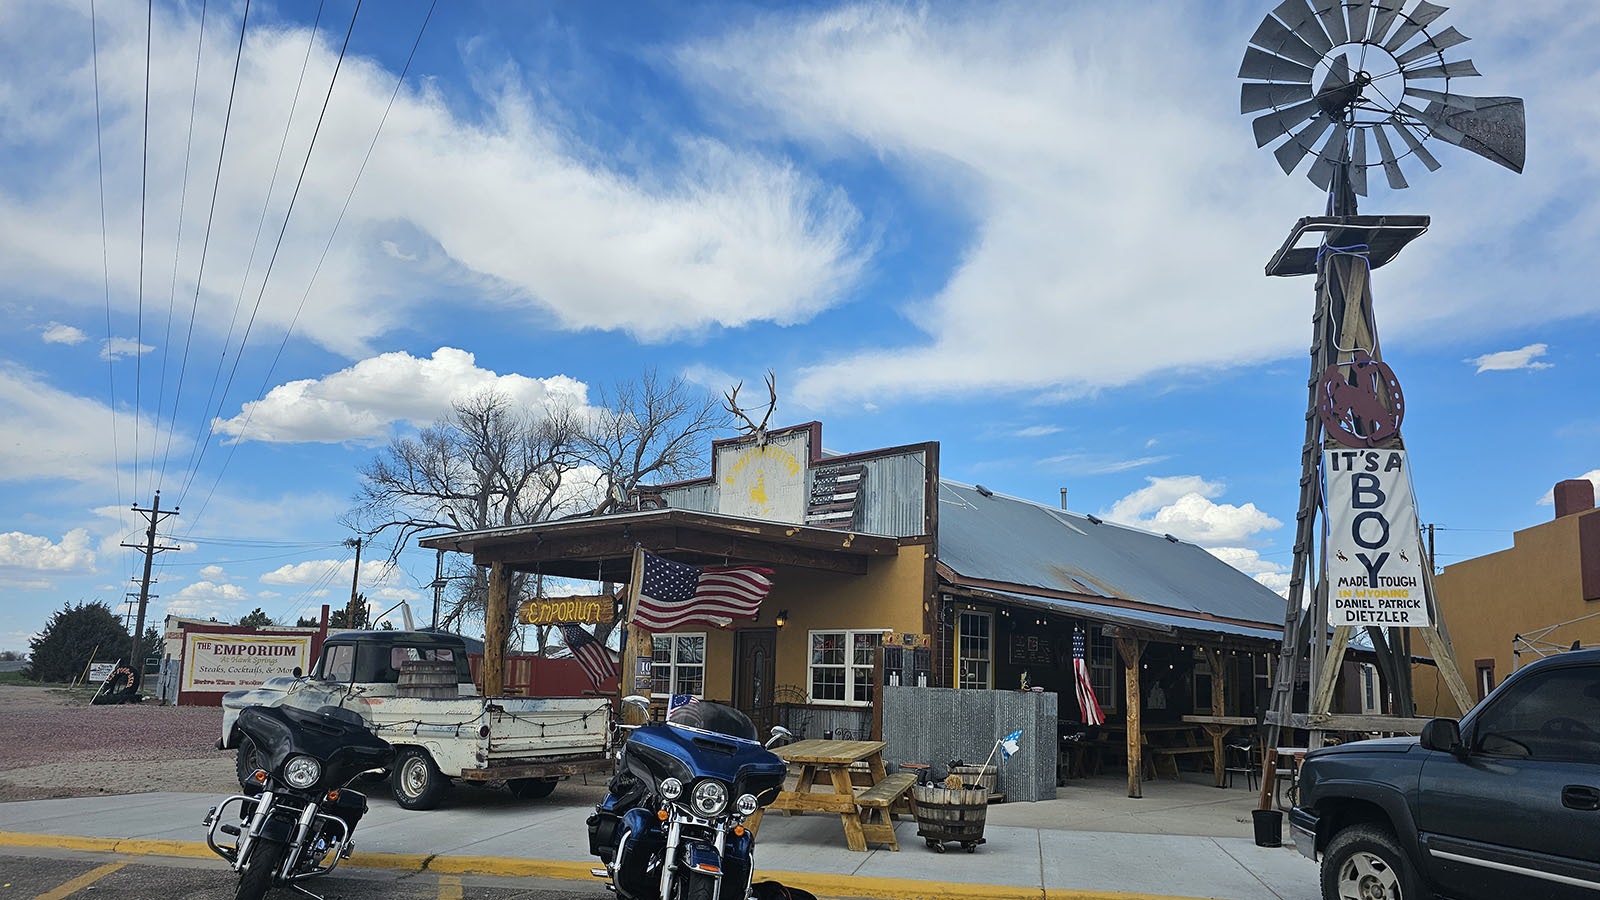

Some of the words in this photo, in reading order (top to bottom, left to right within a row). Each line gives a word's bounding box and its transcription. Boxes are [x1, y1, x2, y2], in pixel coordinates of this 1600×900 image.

[1331, 450, 1380, 472] IT'S
[1384, 452, 1402, 472] A
[1351, 472, 1390, 588] BOY
[1338, 576, 1368, 587] MADE
[1378, 577, 1417, 587] TOUGH
[1338, 589, 1352, 598] IN
[1356, 589, 1409, 598] WYOMING
[1335, 599, 1375, 609] DANIEL
[1379, 599, 1421, 609] PATRICK
[528, 601, 600, 623] EMPORIUM
[1346, 610, 1409, 622] DIETZLER
[197, 642, 211, 650] THE
[213, 644, 297, 656] EMPORIUM
[253, 656, 278, 666] Springs
[199, 665, 226, 674] Steaks,
[228, 666, 264, 676] Cocktails,
